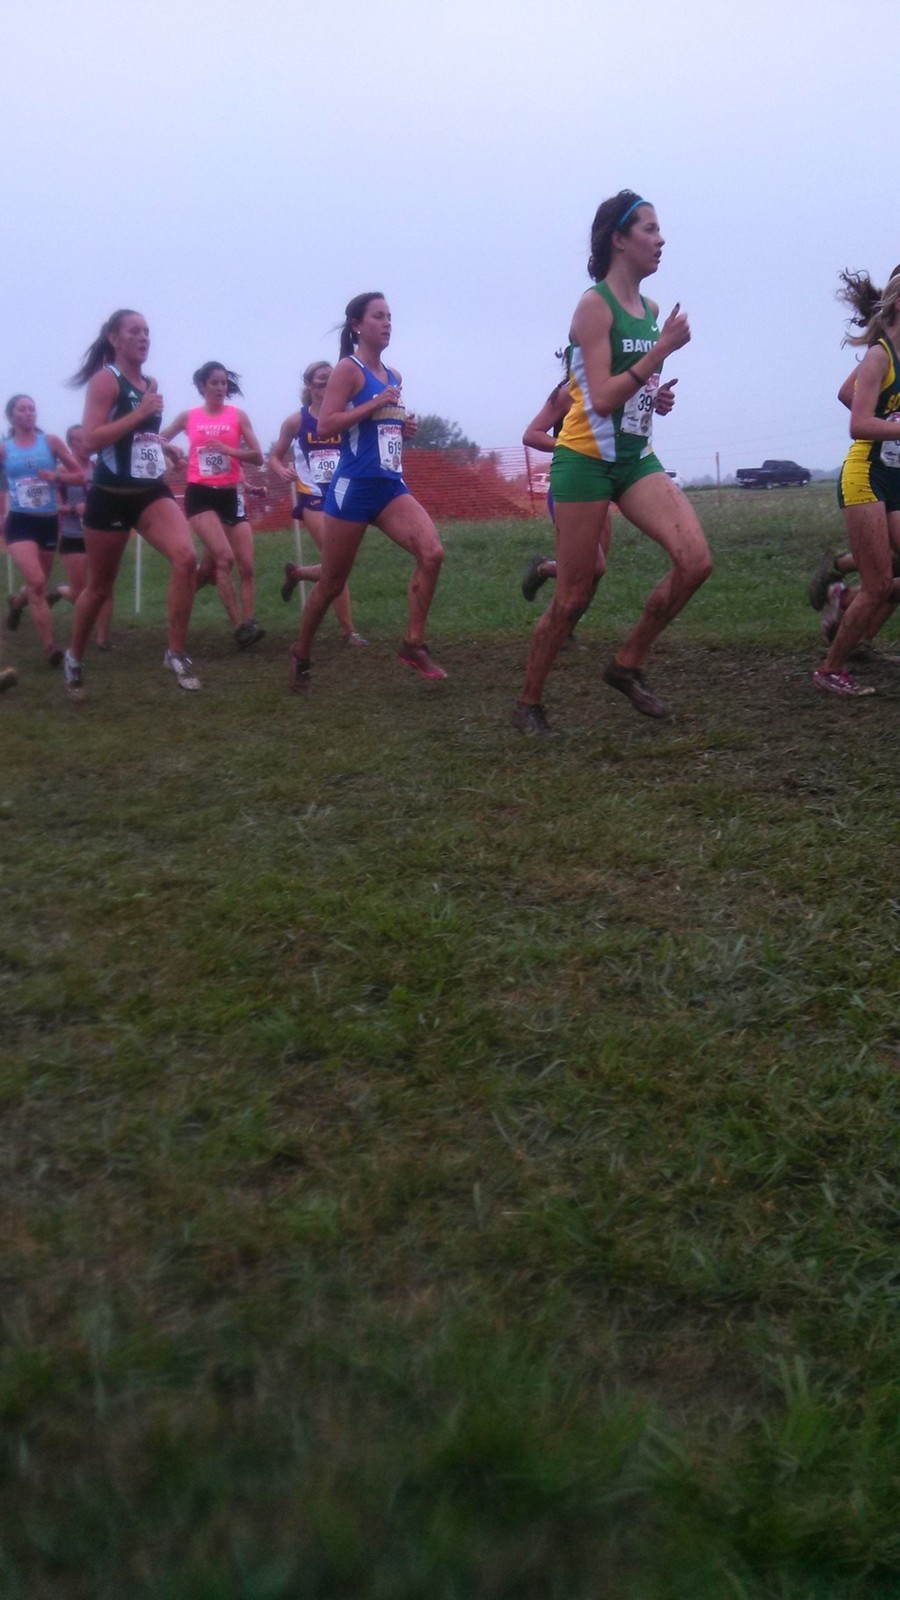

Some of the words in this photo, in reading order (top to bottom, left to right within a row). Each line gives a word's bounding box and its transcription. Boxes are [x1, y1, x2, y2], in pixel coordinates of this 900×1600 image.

[638, 394, 653, 412] 39
[141, 448, 158, 461] 563
[205, 455, 223, 466] 628
[318, 460, 335, 470] 490
